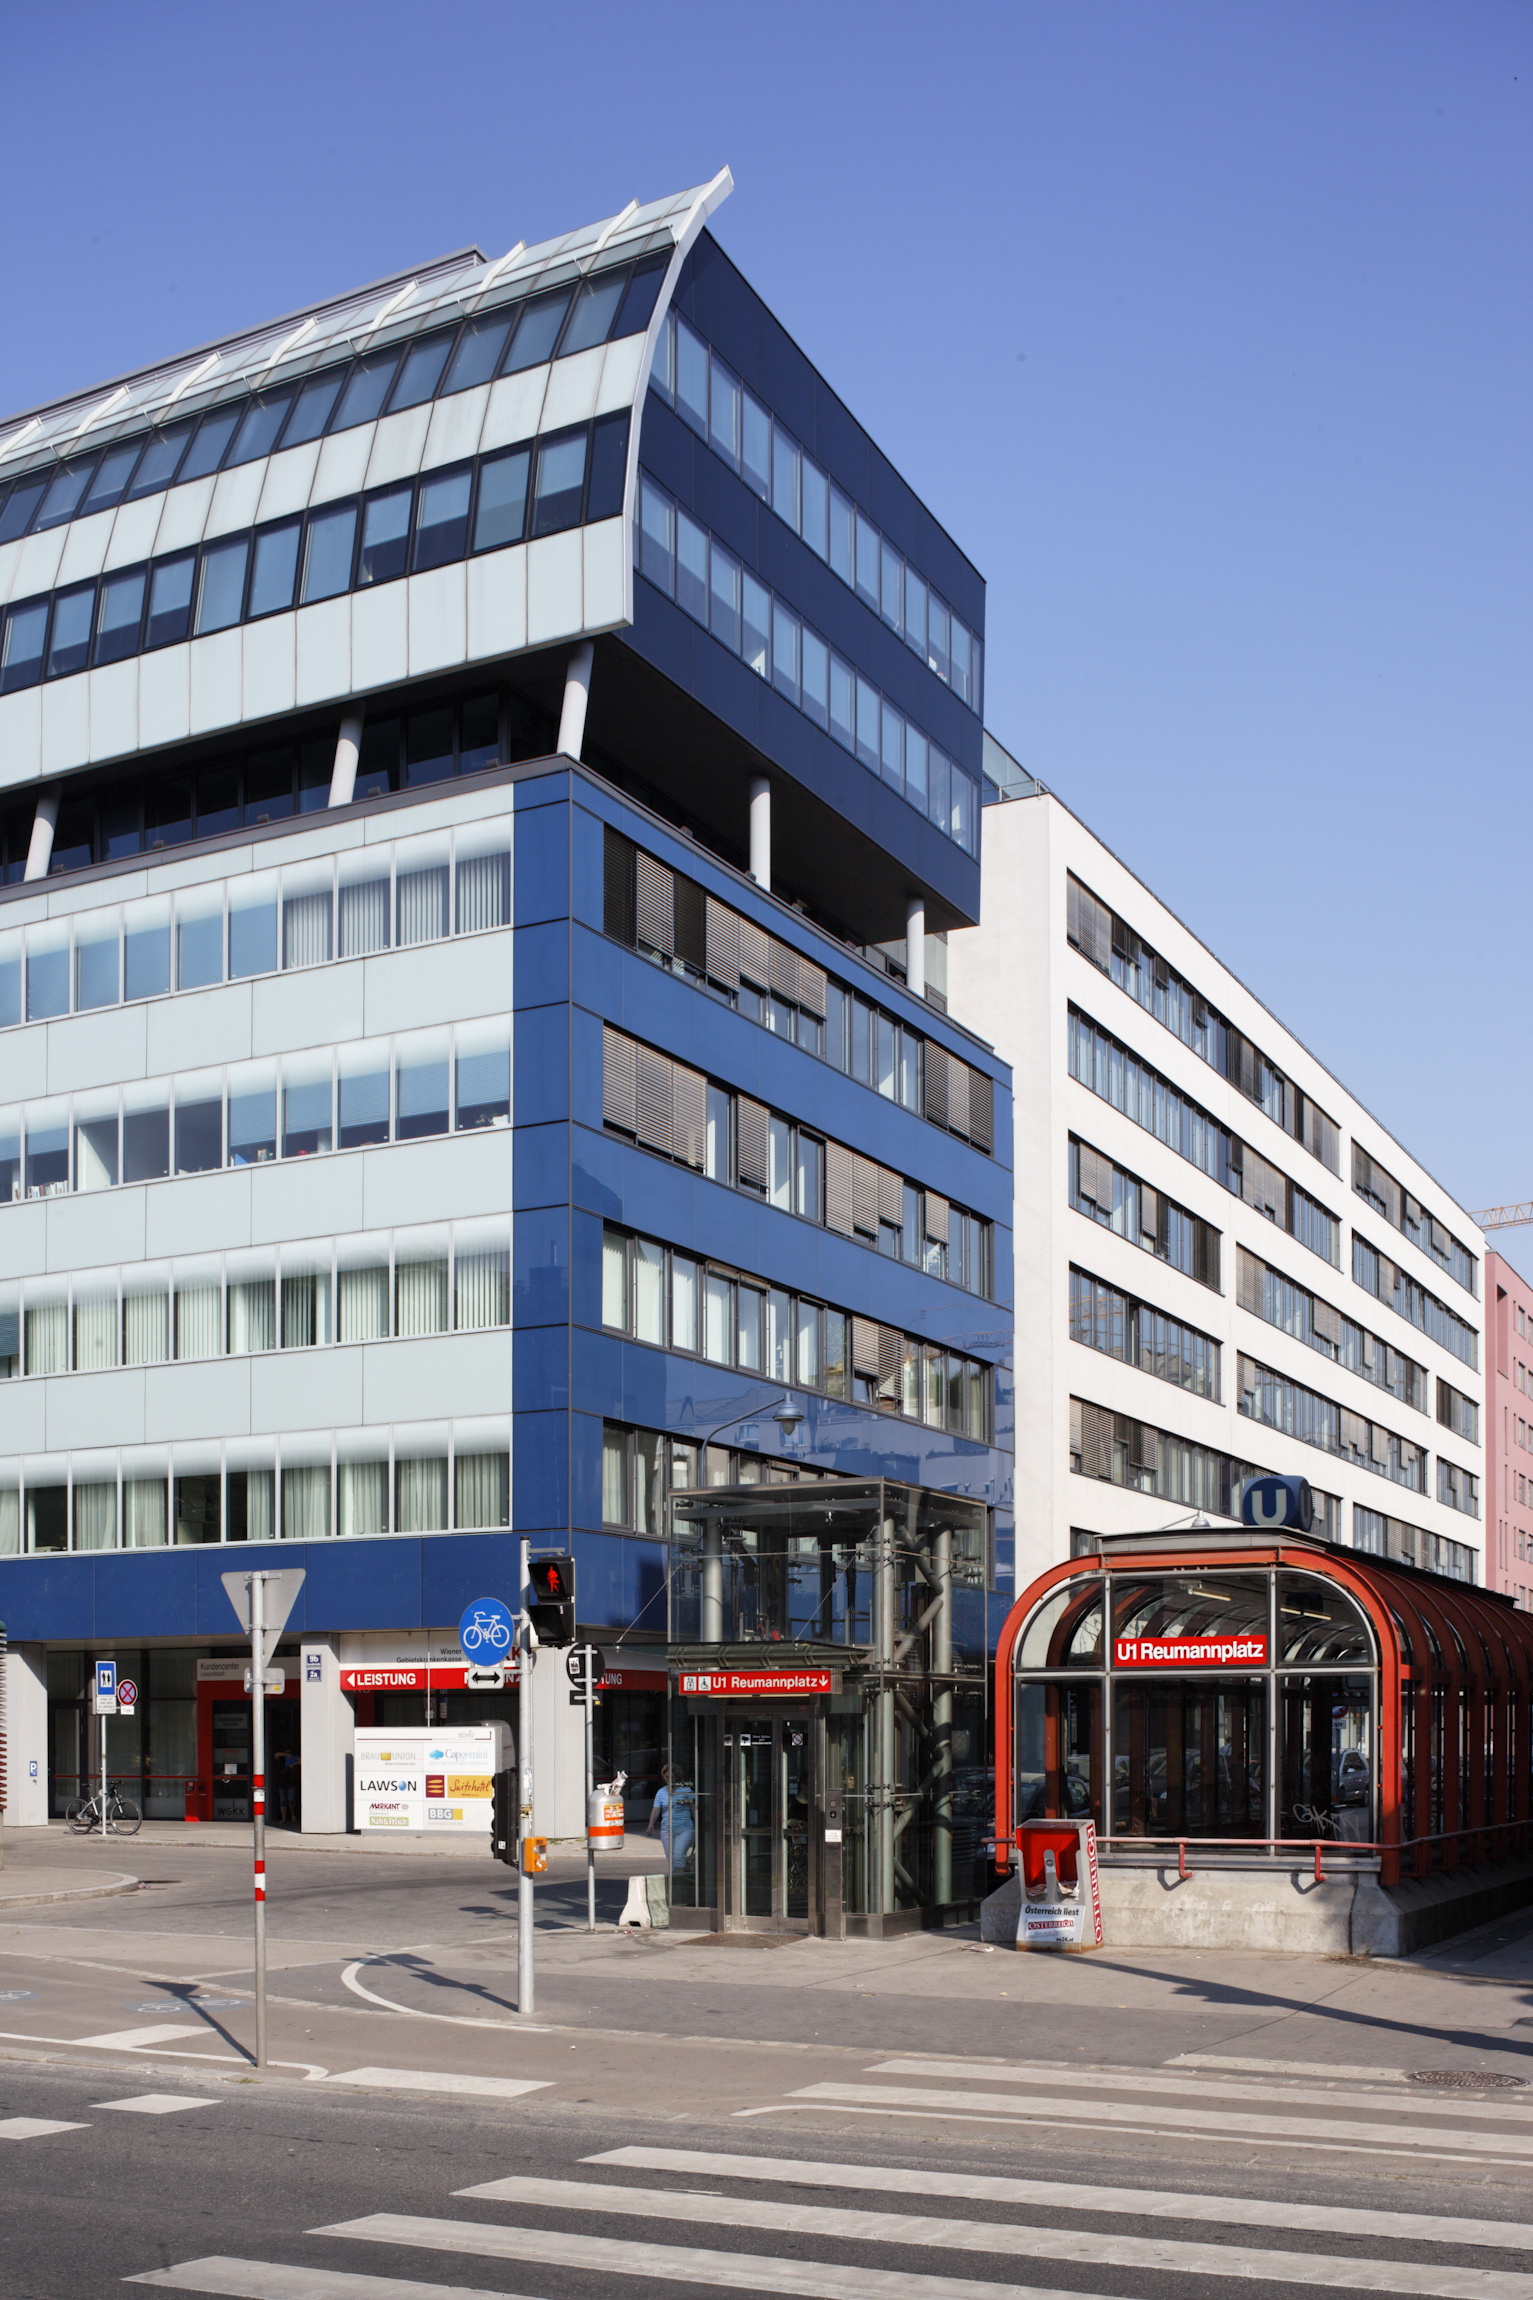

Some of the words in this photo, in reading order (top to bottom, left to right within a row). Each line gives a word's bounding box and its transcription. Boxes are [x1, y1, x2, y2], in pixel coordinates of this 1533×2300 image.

[1251, 1488, 1287, 1526] U
[1117, 1643, 1137, 1660] U1
[1140, 1641, 1264, 1663] Reumannplatz
[200, 1662, 240, 1671] Kundencenter
[356, 1673, 417, 1686] LEISTUNG
[712, 1676, 727, 1689] U1
[731, 1675, 818, 1690] Reumannplatz
[360, 1752, 380, 1761] BRAU
[392, 1752, 416, 1761] UNION
[445, 1748, 489, 1762] Capgemini
[30, 1762, 37, 1773] P
[360, 1780, 417, 1792] LAWSON
[449, 1778, 491, 1793] Suitehotel
[369, 1802, 401, 1810] MARKANT
[429, 1808, 452, 1819] BBG
[1025, 1905, 1062, 1916] Österreich
[1063, 1907, 1080, 1916] liest
